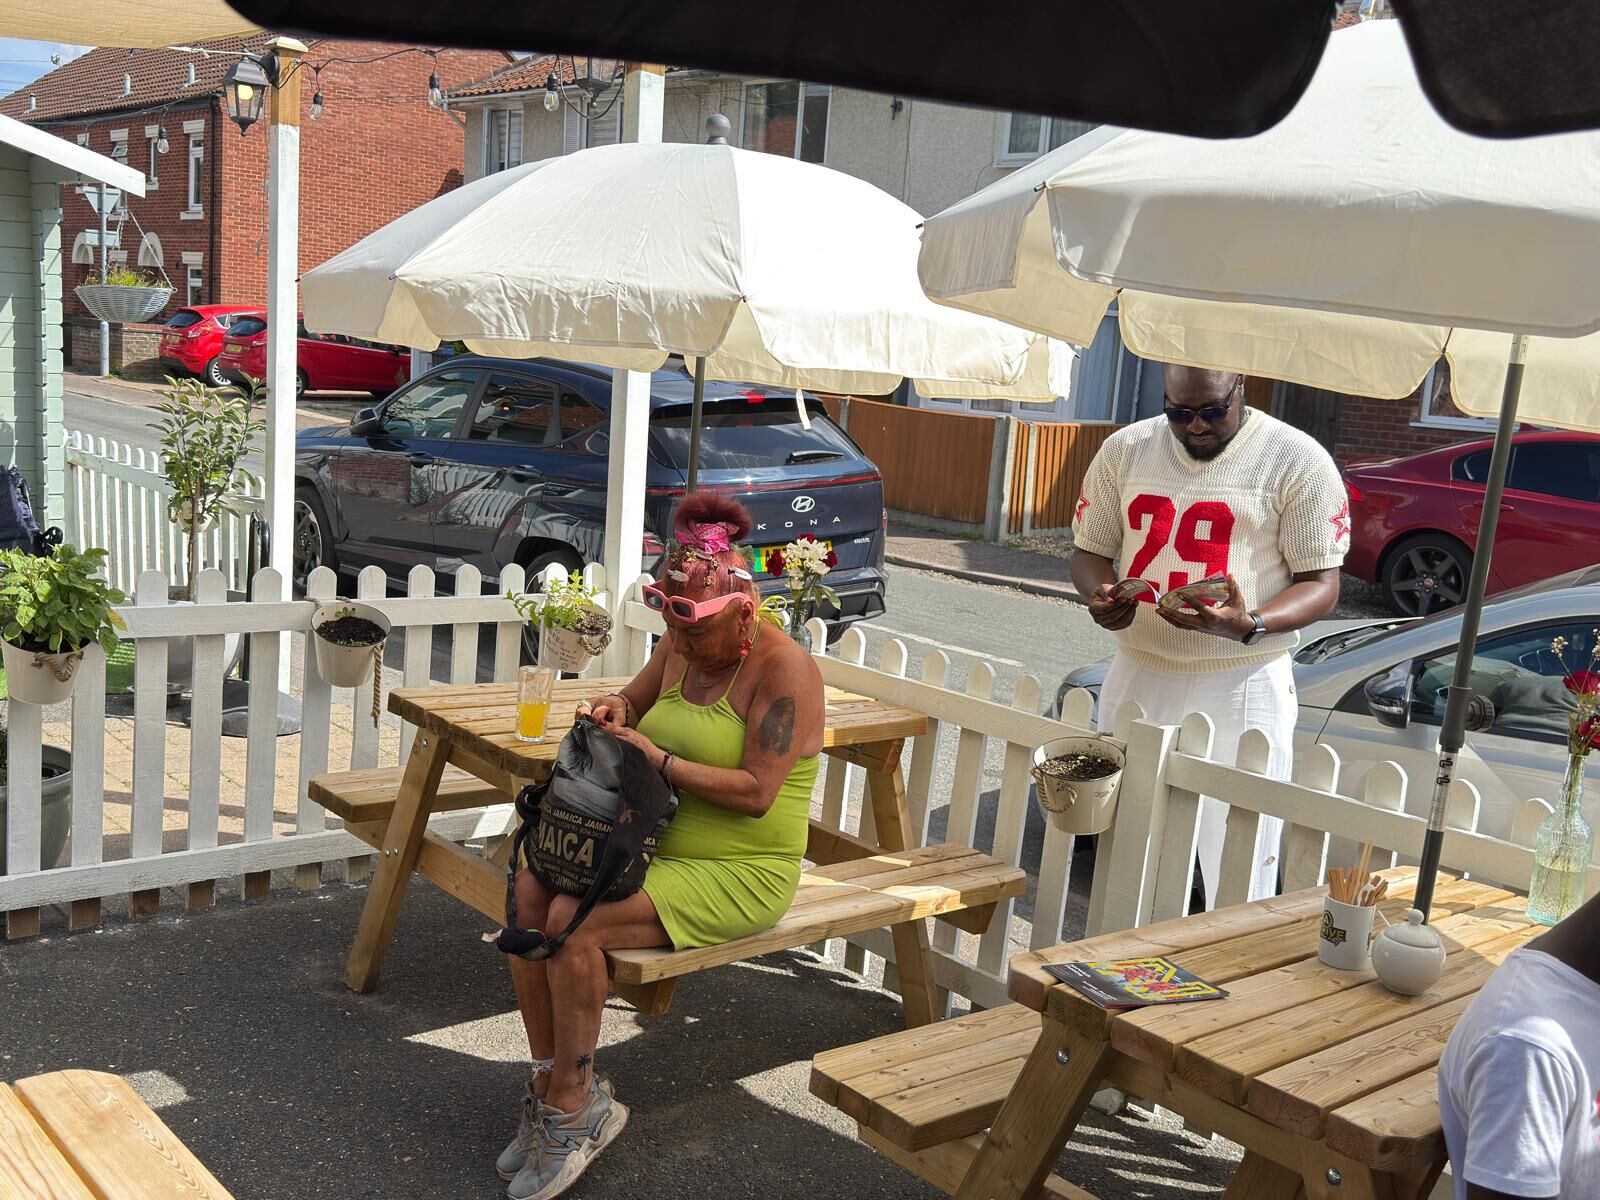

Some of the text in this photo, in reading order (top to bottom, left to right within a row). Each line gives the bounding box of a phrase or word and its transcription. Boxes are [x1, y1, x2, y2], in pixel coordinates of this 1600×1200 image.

[757, 516, 841, 531] KONA
[853, 537, 870, 545] electric
[1127, 494, 1235, 608] 29
[552, 808, 583, 825] JAMAICA
